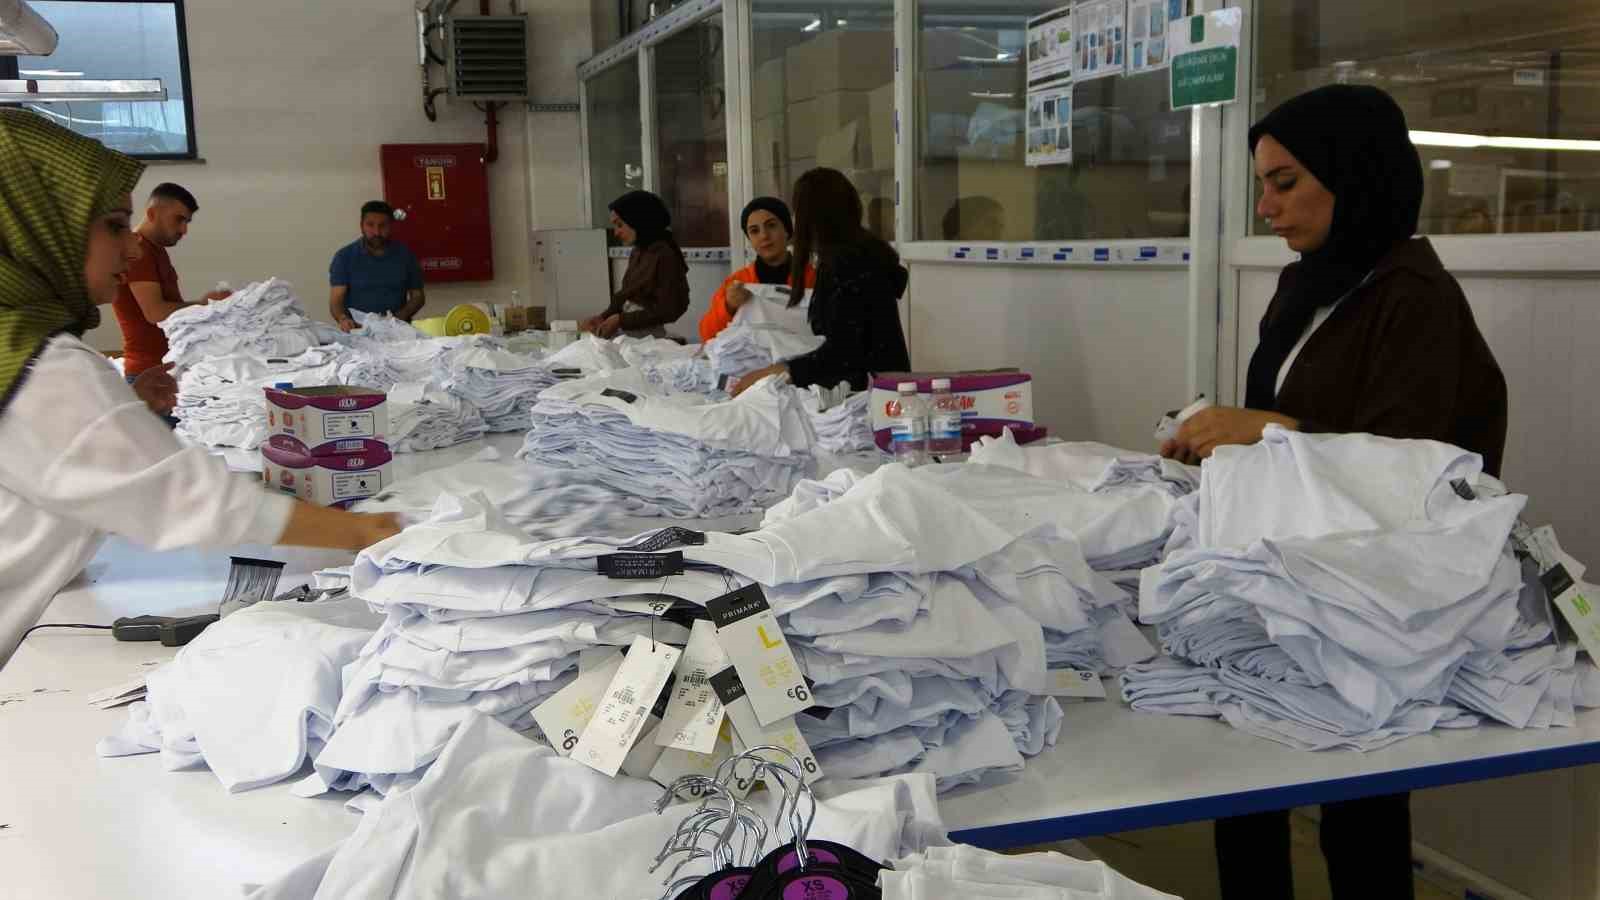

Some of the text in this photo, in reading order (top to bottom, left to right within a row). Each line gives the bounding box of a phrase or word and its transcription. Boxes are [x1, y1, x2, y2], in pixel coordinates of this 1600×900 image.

[721, 601, 760, 618] PRIMARK
[757, 624, 782, 649] L
[726, 682, 743, 696] PRI
[786, 684, 809, 702] €6
[562, 728, 580, 751] €6
[802, 756, 818, 774] 6
[801, 880, 825, 893] XS
